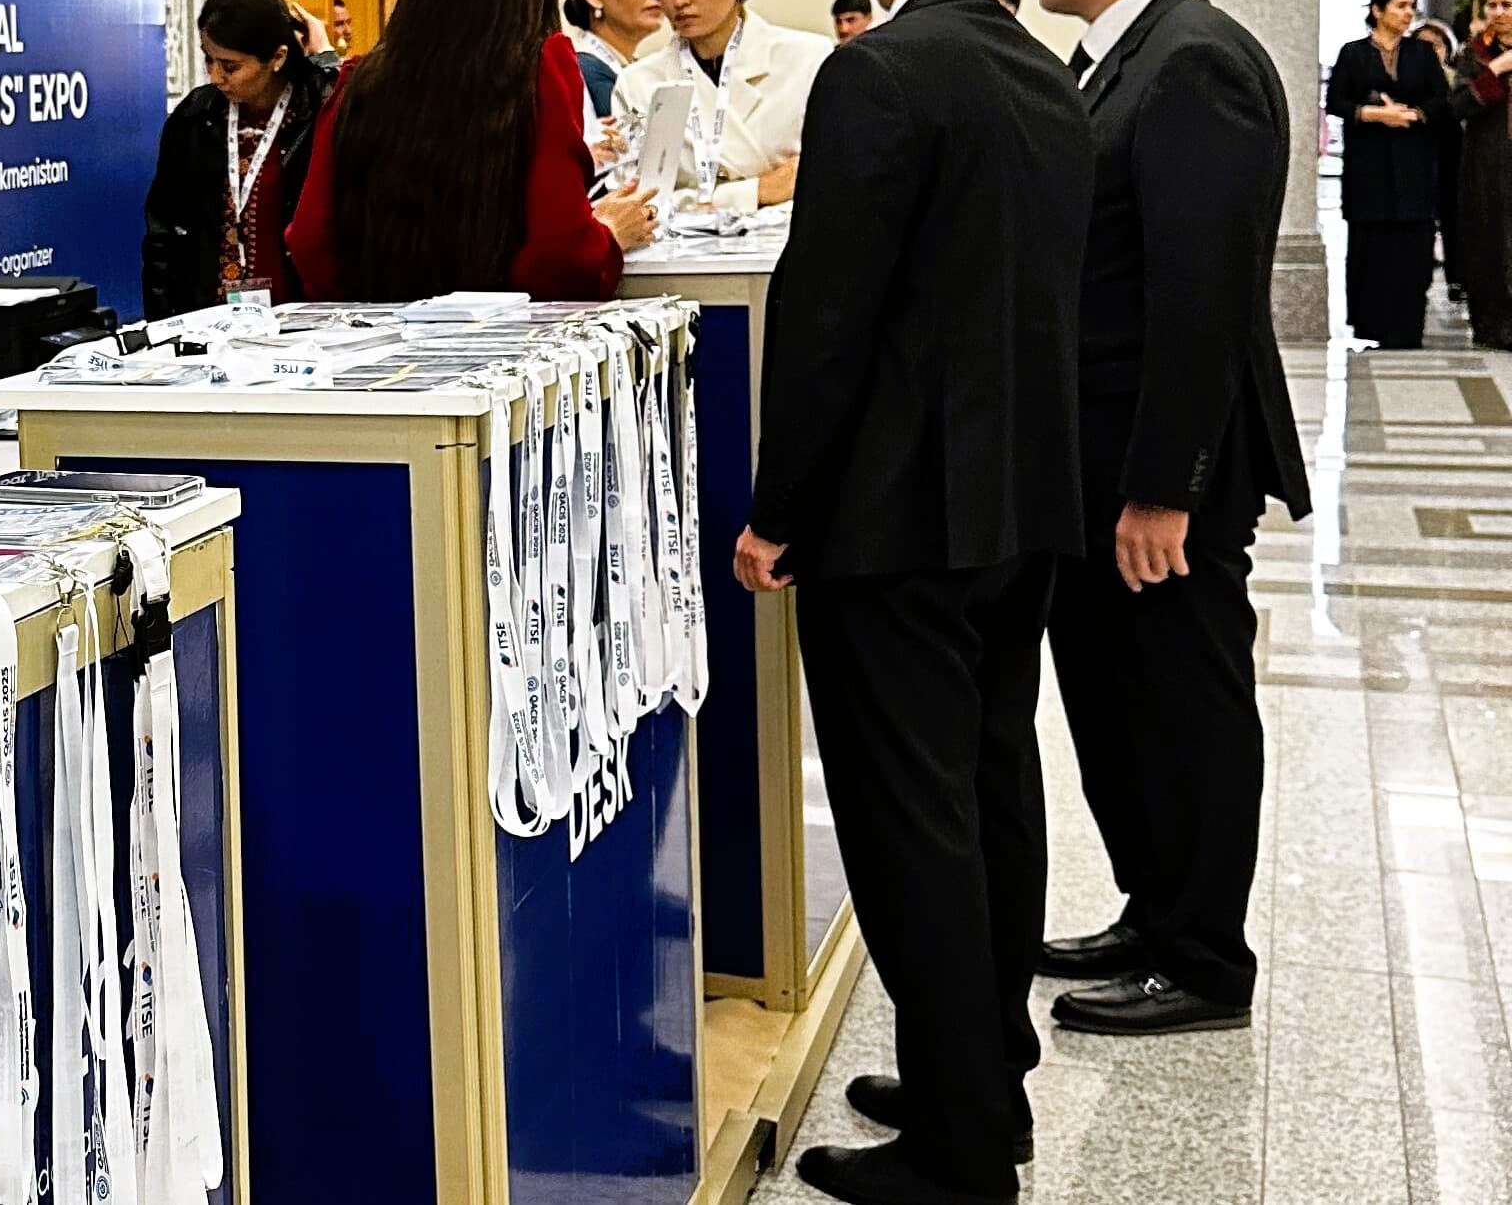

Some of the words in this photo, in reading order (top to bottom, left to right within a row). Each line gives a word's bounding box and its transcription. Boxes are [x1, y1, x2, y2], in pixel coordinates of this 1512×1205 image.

[28, 71, 89, 123] EXPO
[585, 370, 593, 396] ITSE
[558, 491, 567, 521] QACIS
[610, 543, 619, 568] ITSE
[667, 529, 679, 556] ITSE
[557, 602, 566, 628] ITSE
[496, 621, 508, 649] ITSE
[530, 618, 539, 645] ITSE
[1, 666, 10, 703] 2025
[2, 707, 10, 757] QACIS
[8, 856, 18, 900] ITSE
[141, 991, 153, 1039] ITSE
